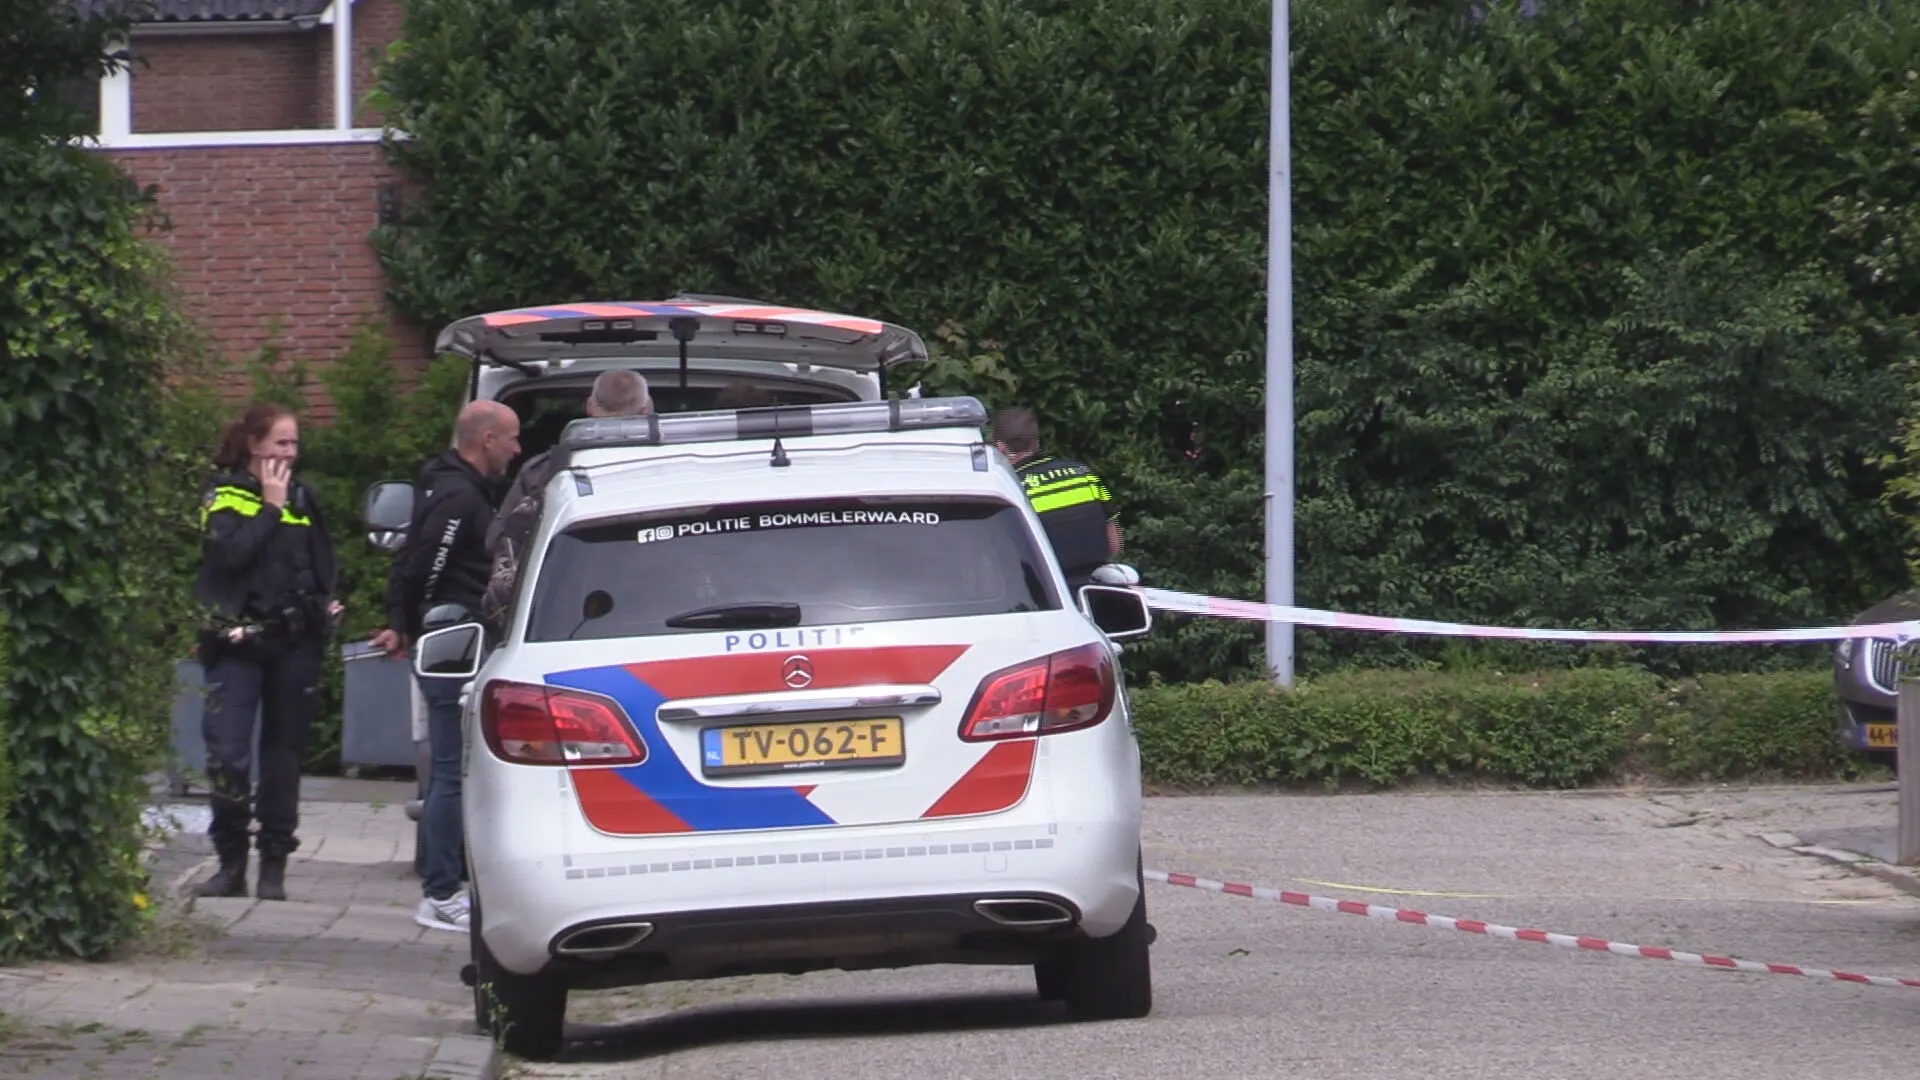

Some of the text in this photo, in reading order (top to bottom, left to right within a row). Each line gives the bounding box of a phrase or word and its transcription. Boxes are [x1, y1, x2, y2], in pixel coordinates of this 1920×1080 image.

[441, 518, 462, 546] THE
[677, 510, 940, 537] POLITIE BOMMELERWAARD
[732, 723, 888, 760] TV-062-F
